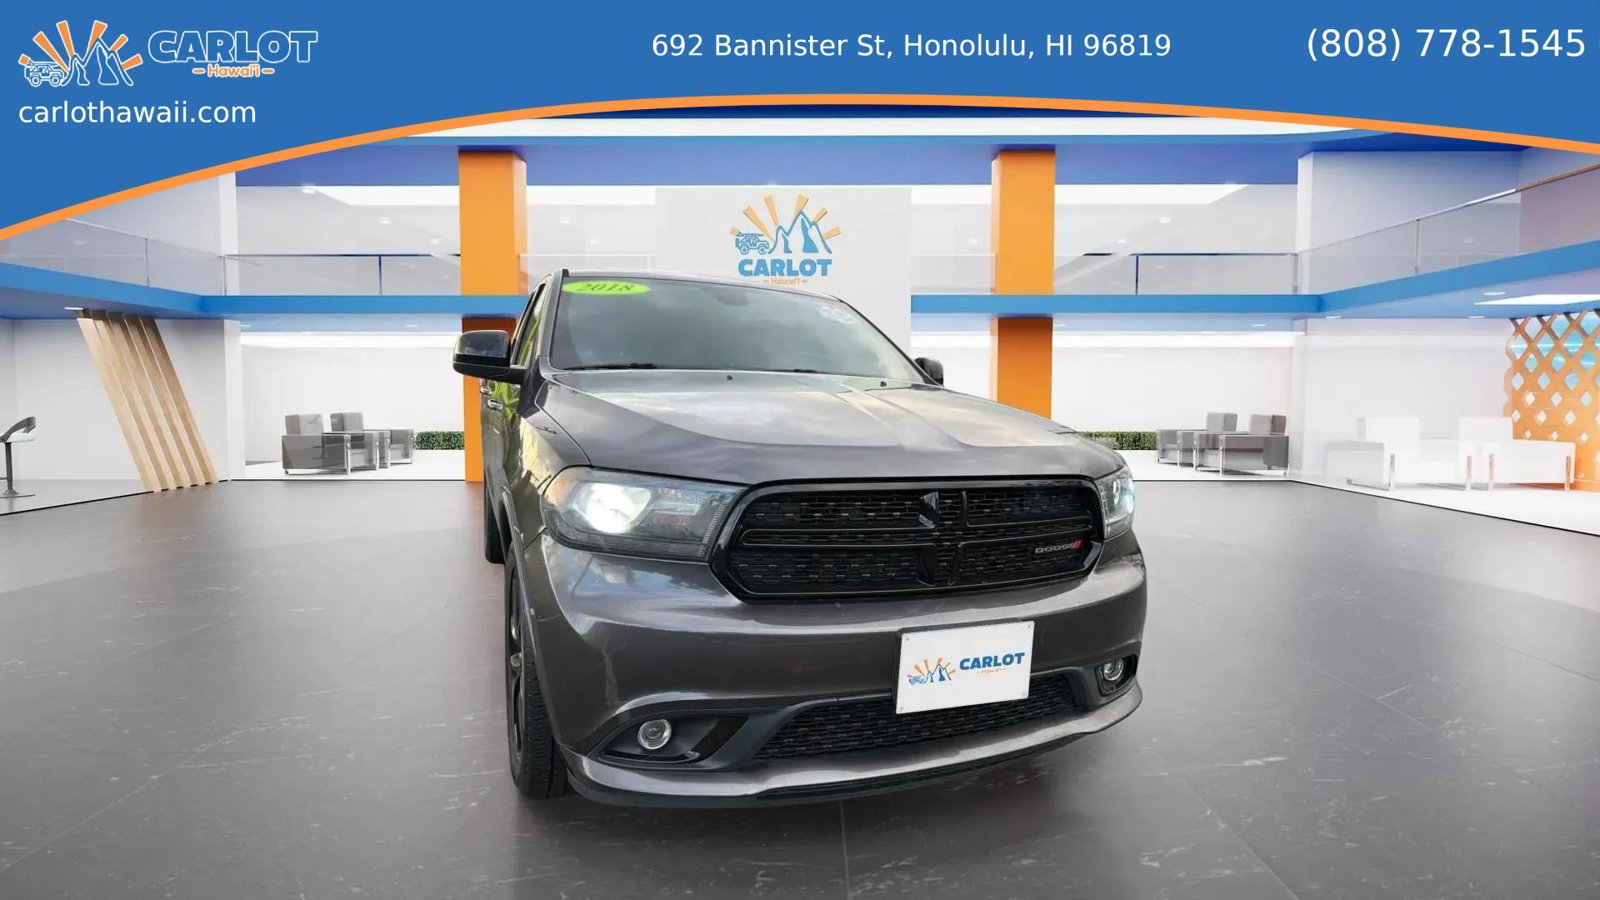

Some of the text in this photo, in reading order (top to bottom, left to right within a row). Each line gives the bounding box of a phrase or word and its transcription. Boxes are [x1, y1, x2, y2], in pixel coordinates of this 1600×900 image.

[738, 258, 832, 277] CARLOT
[574, 282, 635, 292] 2018
[1034, 543, 1075, 554] DODGE
[959, 652, 1026, 671] CARLOT
